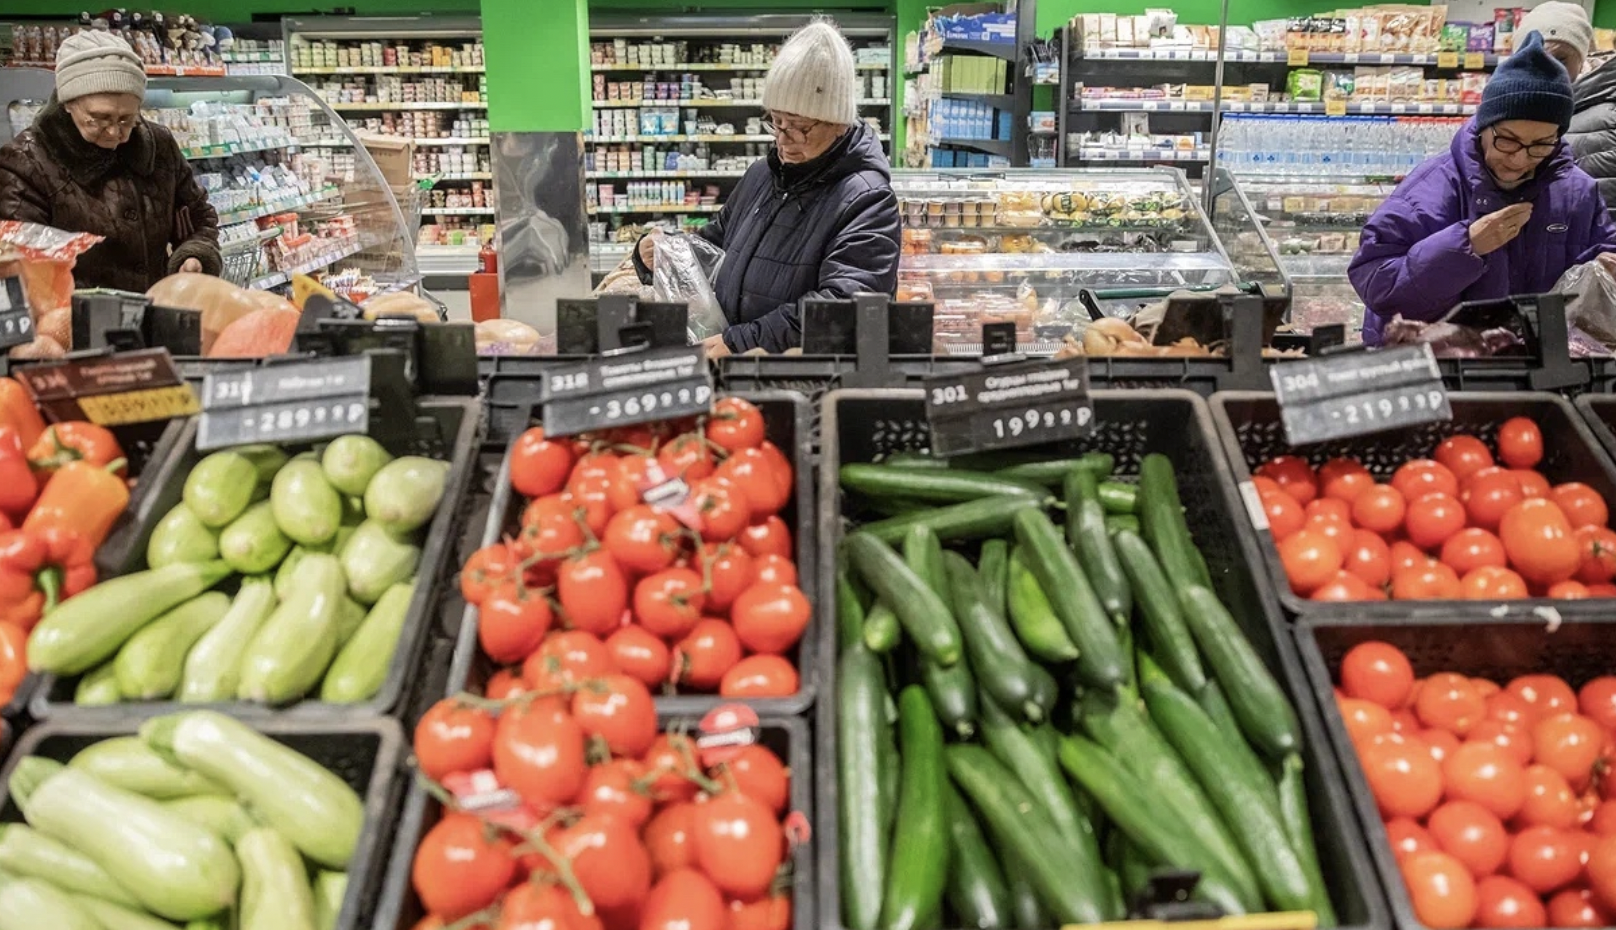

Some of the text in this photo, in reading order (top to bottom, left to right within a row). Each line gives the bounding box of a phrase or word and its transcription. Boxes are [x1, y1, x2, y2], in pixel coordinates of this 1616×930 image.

[551, 372, 589, 392] 318
[1283, 372, 1319, 393] 304
[932, 385, 968, 405] 301
